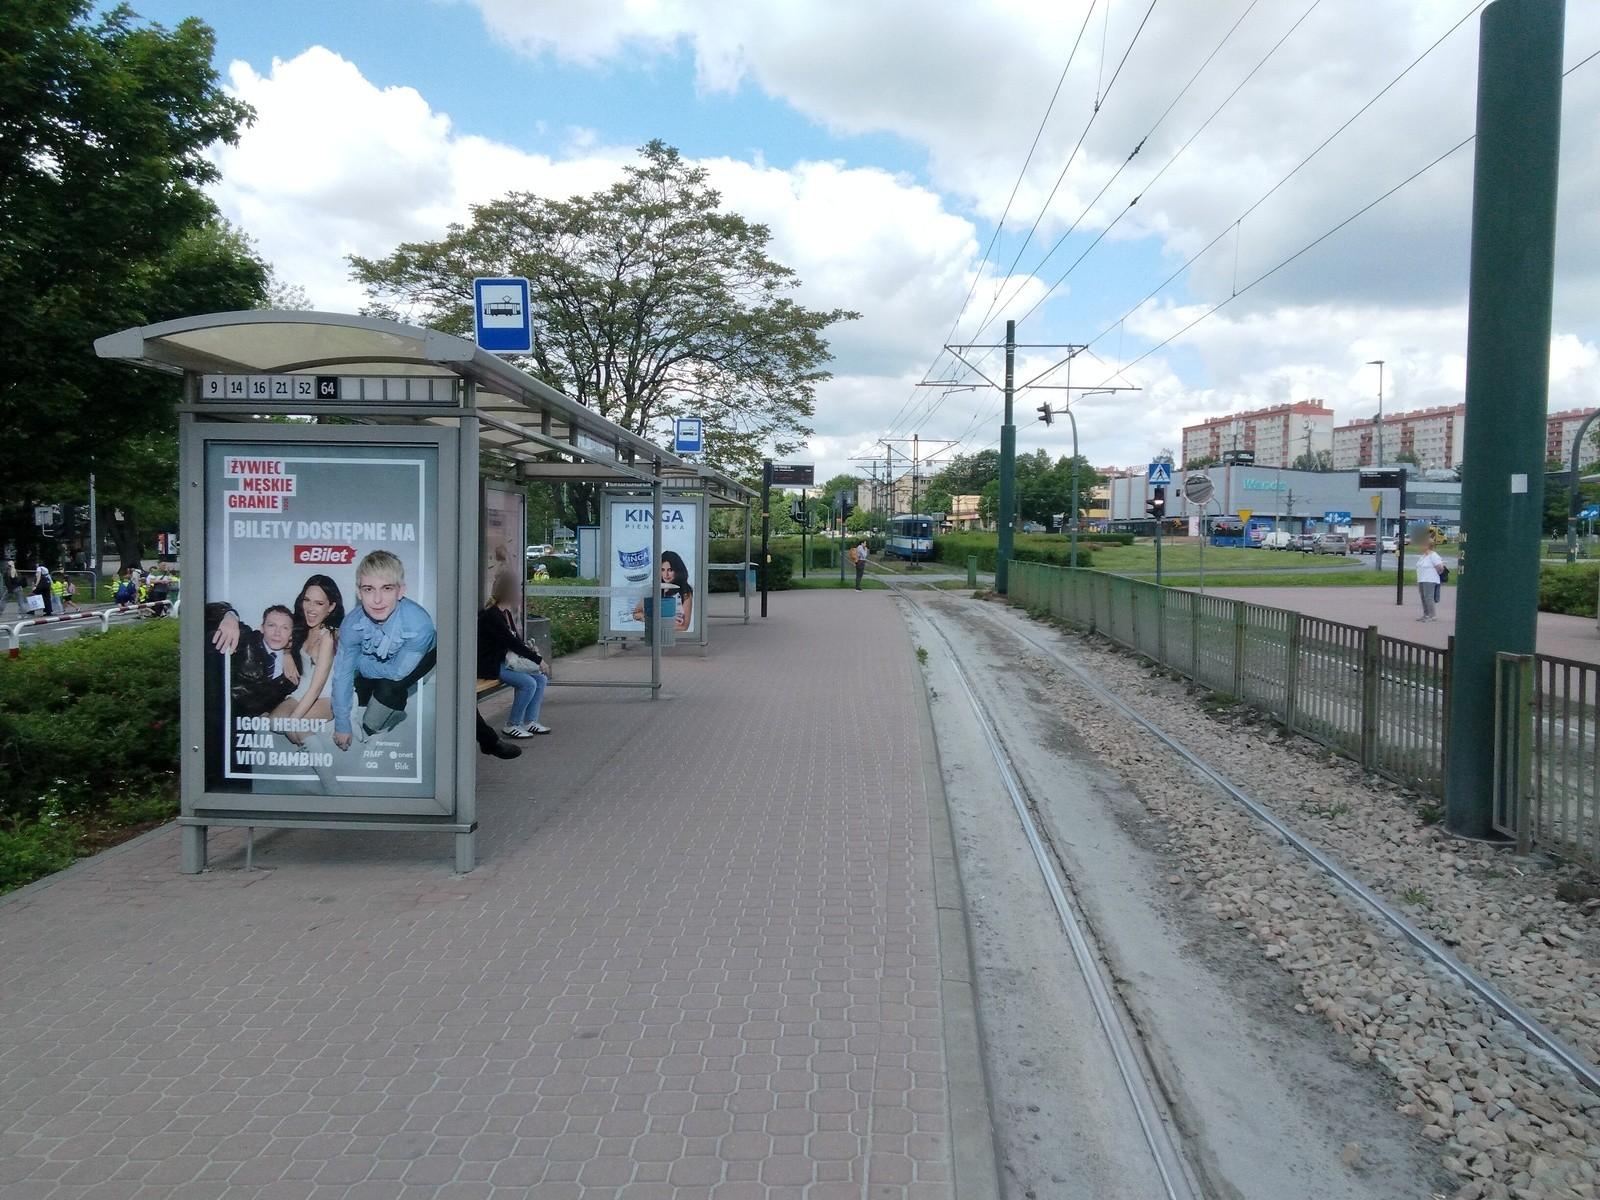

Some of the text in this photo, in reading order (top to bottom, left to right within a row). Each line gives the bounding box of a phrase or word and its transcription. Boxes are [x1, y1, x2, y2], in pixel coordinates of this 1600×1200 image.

[210, 381, 335, 394] 9 14 16 21 52 64
[243, 478, 293, 493] MĘSKIE
[228, 494, 278, 509] GRANIE
[233, 520, 415, 542] BILETY DOSTĘPNE NA
[300, 547, 348, 562] eBilet
[236, 716, 328, 733] IGOR HERBUT
[236, 733, 273, 749] ZALIA
[236, 751, 333, 767] VITO BAMBINO
